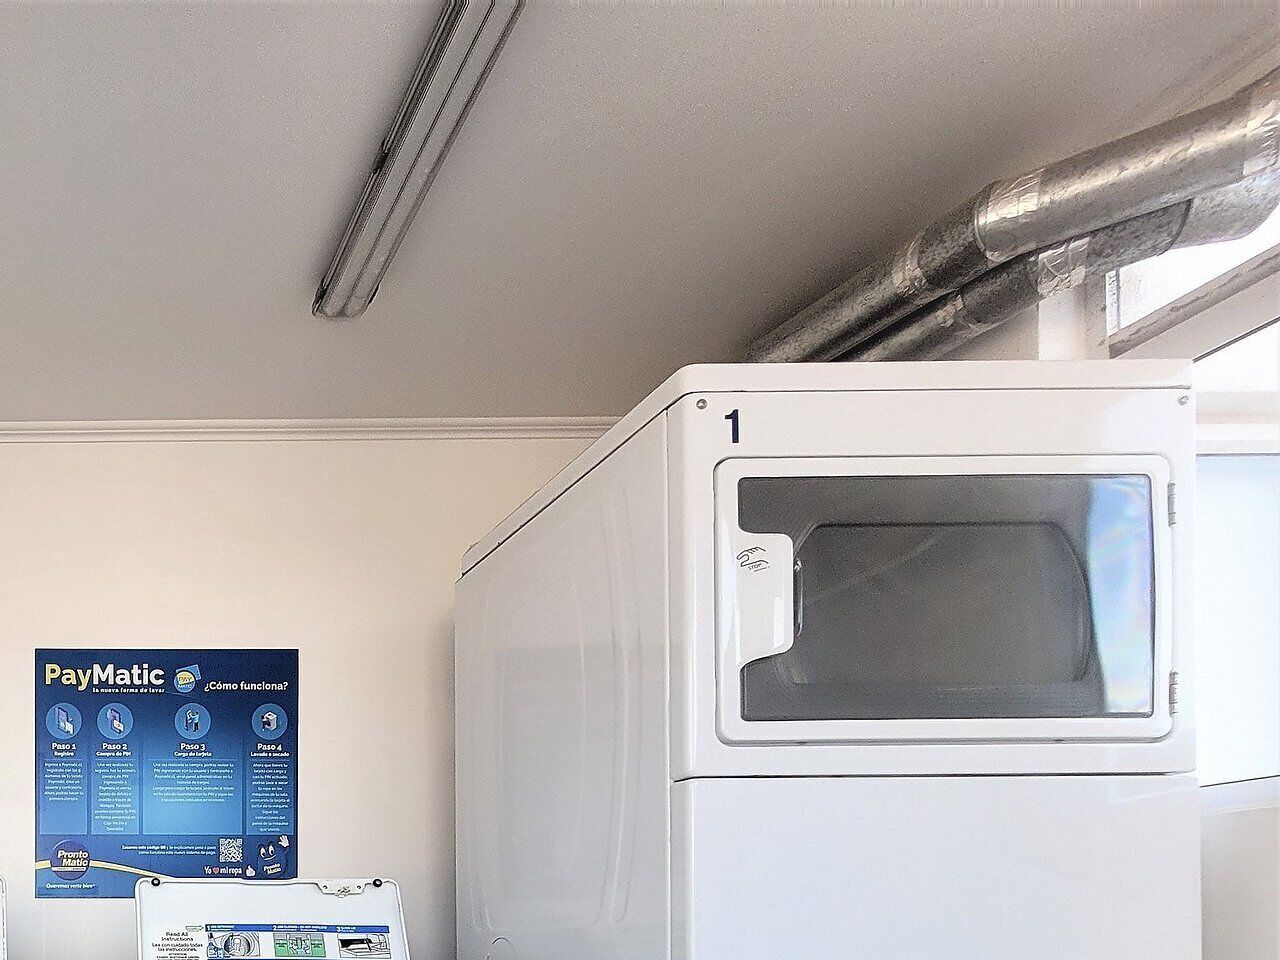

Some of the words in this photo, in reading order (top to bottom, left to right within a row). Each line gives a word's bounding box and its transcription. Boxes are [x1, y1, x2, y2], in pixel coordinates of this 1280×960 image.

[724, 409, 740, 443] 1
[45, 663, 165, 691] PayMatic
[204, 681, 238, 691] ¿Cómo
[240, 681, 289, 690] funciona?
[51, 742, 70, 750] Paso
[71, 742, 76, 750] 1
[102, 742, 121, 750] Paso
[122, 742, 128, 750] 2
[200, 743, 206, 751] 3
[257, 743, 275, 751] Paso
[276, 743, 282, 751] 4
[57, 850, 89, 859] Pronto
[62, 858, 88, 867] Matic
[204, 866, 212, 874] Yo
[220, 866, 228, 874] mi
[228, 867, 243, 876] ropa
